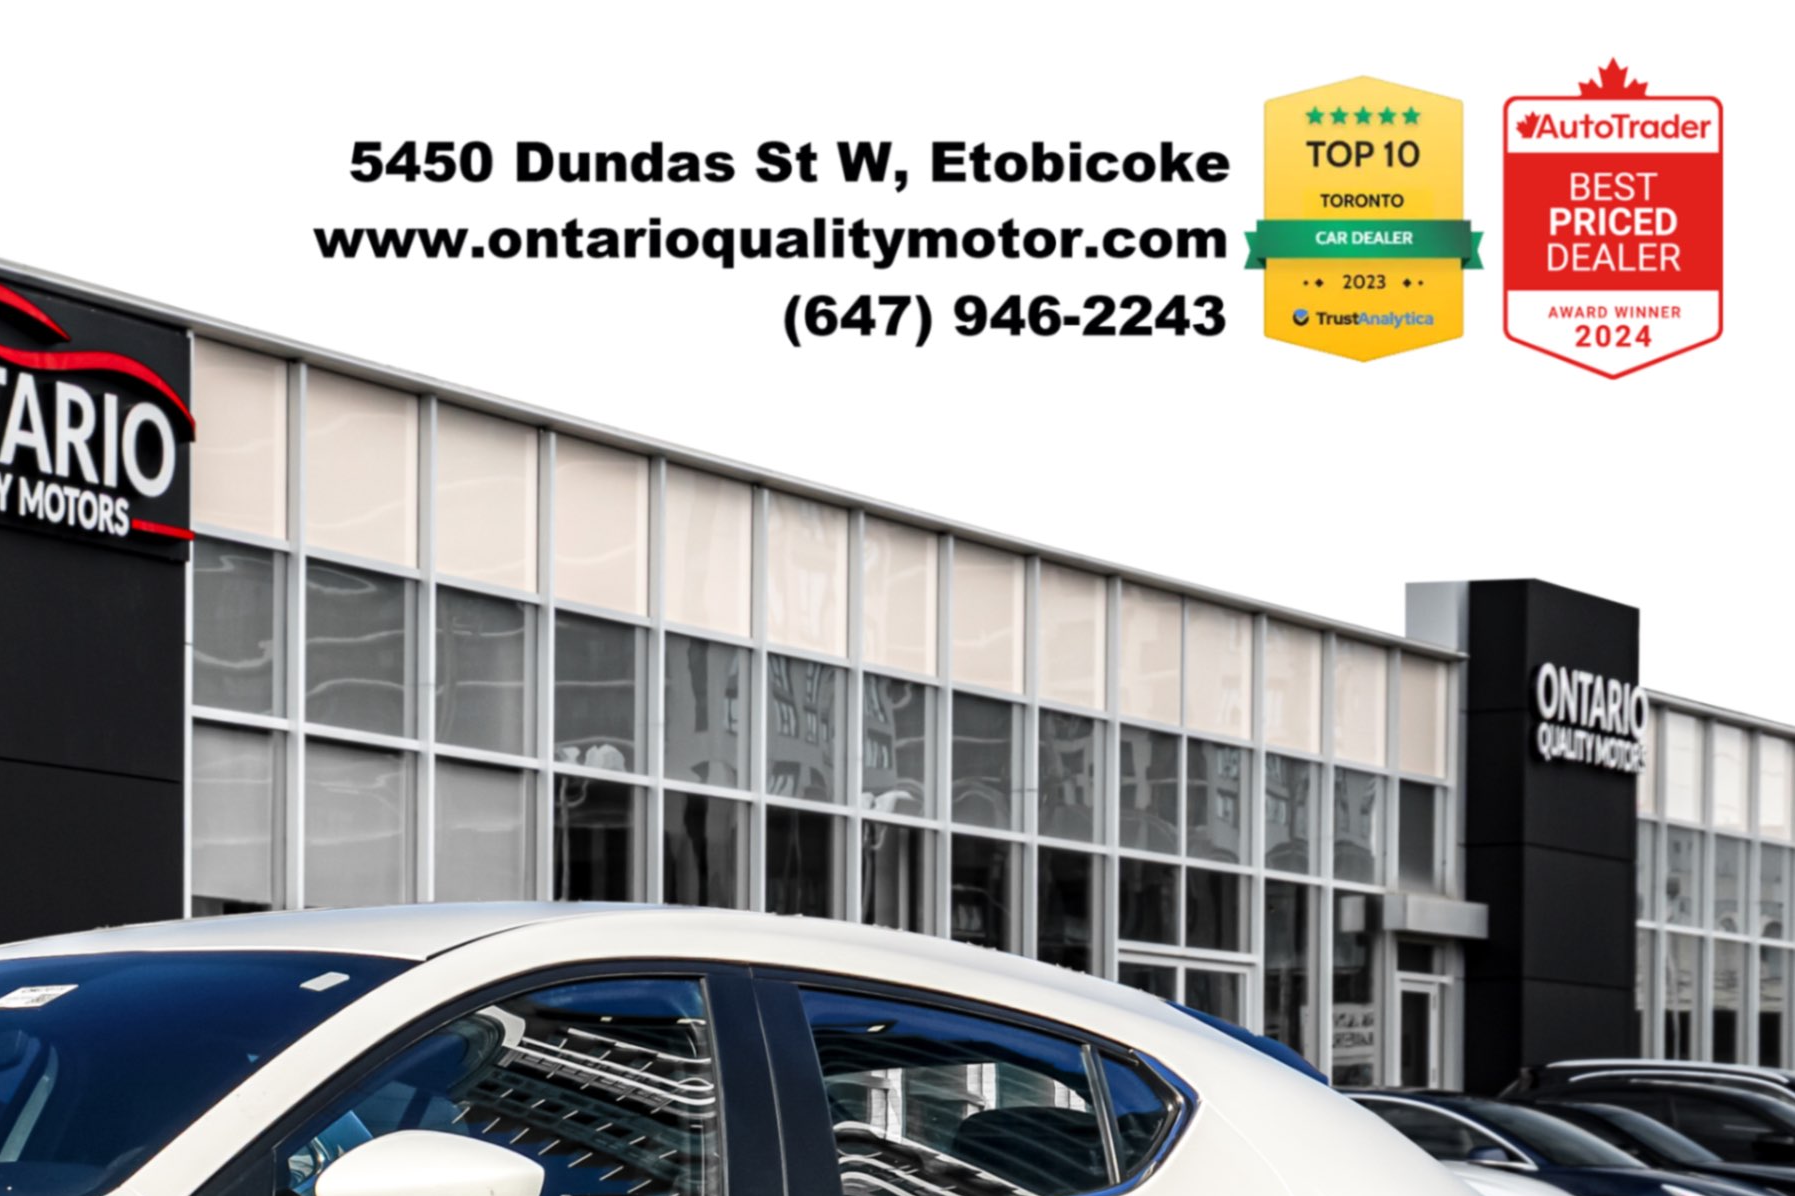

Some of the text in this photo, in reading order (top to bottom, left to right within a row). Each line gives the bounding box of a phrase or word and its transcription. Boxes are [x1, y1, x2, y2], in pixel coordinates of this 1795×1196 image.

[19, 477, 130, 536] MOTORS
[1537, 662, 1649, 740] ONTARIO
[1537, 722, 1593, 763] QUALITY
